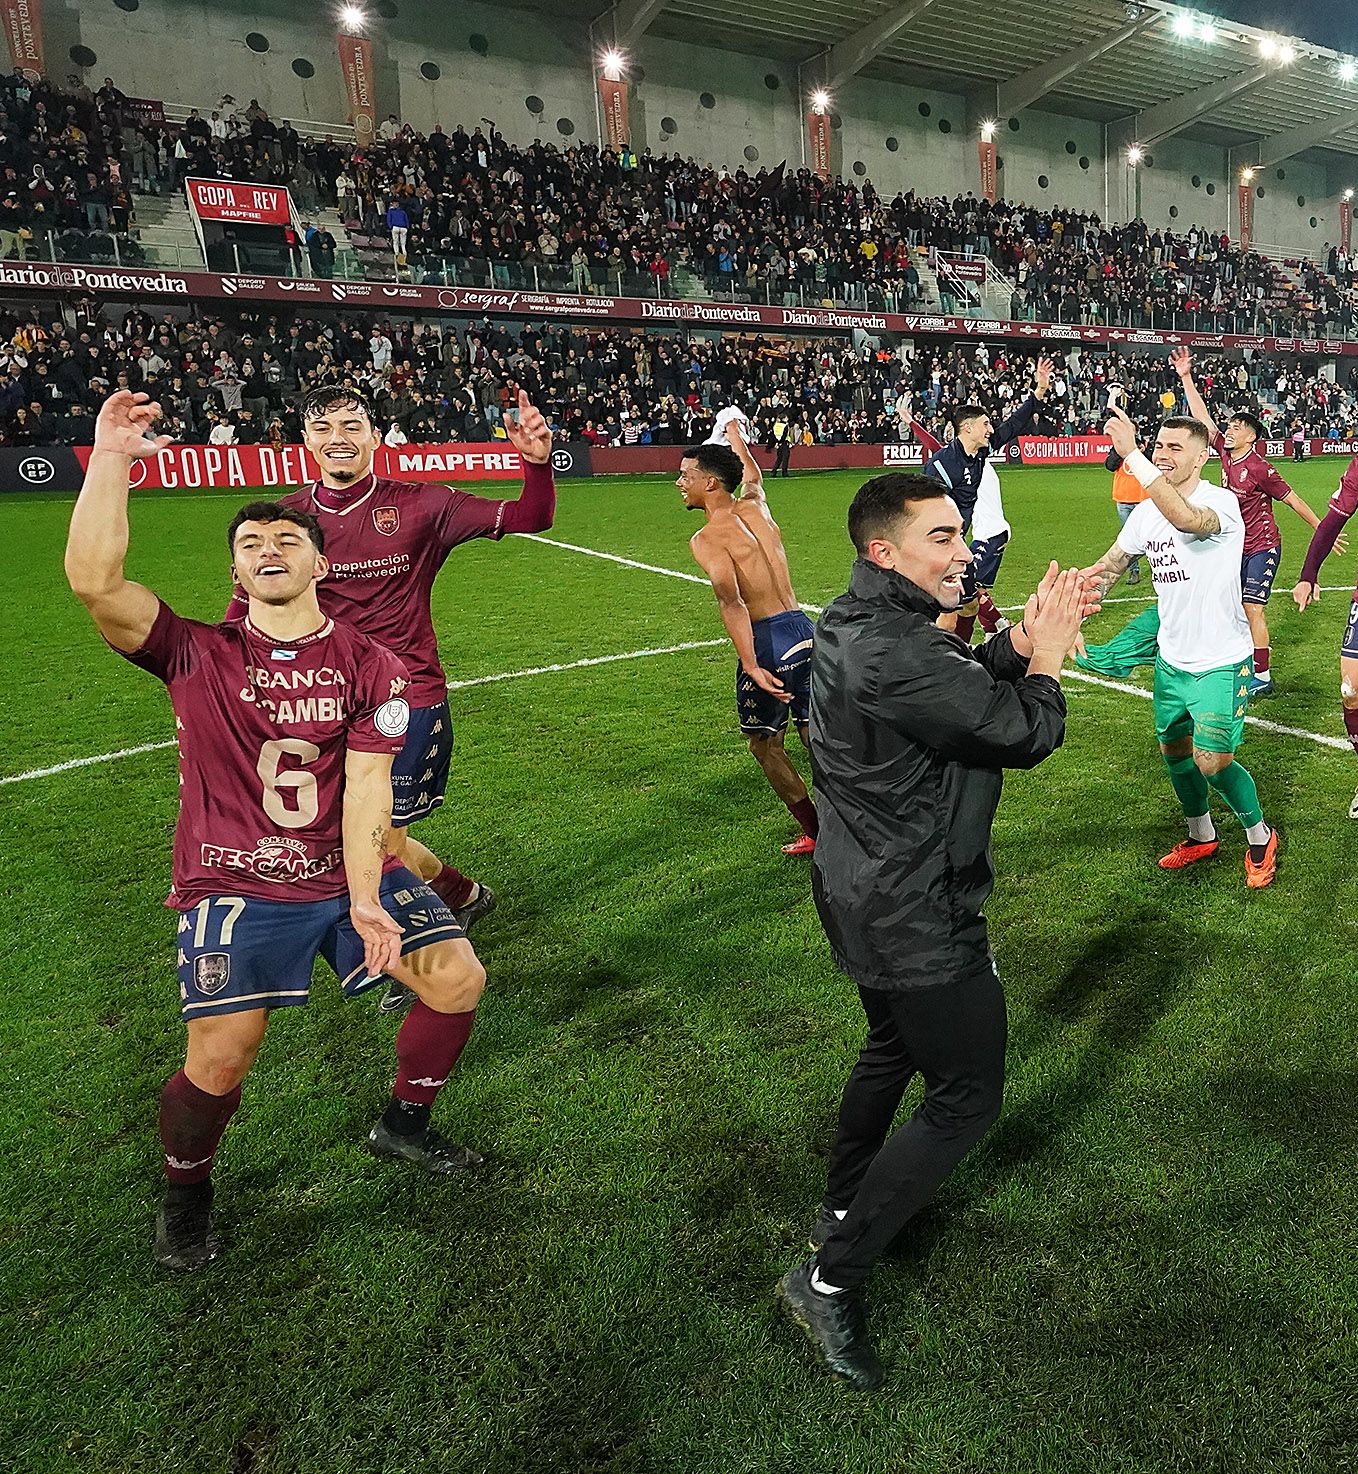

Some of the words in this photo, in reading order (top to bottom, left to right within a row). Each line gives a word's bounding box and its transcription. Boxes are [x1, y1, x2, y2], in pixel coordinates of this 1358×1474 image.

[354, 46, 370, 107] PONTEVEDRA
[197, 185, 236, 208] COPA
[252, 190, 278, 211] REY
[220, 209, 262, 220] MAPFRE
[460, 290, 521, 311] sergraf
[1040, 329, 1082, 340] PESCAMAR
[1127, 334, 1165, 343] PESCAMAR
[883, 444, 923, 460] FROIZ
[1036, 442, 1059, 458] COPA
[1059, 442, 1073, 457] DEL
[1073, 441, 1090, 457] REY
[1322, 441, 1352, 454] Estrella
[158, 447, 242, 489] COPA
[259, 443, 320, 487] DEL
[398, 452, 521, 472] MAPFRE
[331, 552, 410, 573] Deputación
[256, 737, 321, 829] 6
[193, 896, 247, 949] 17
